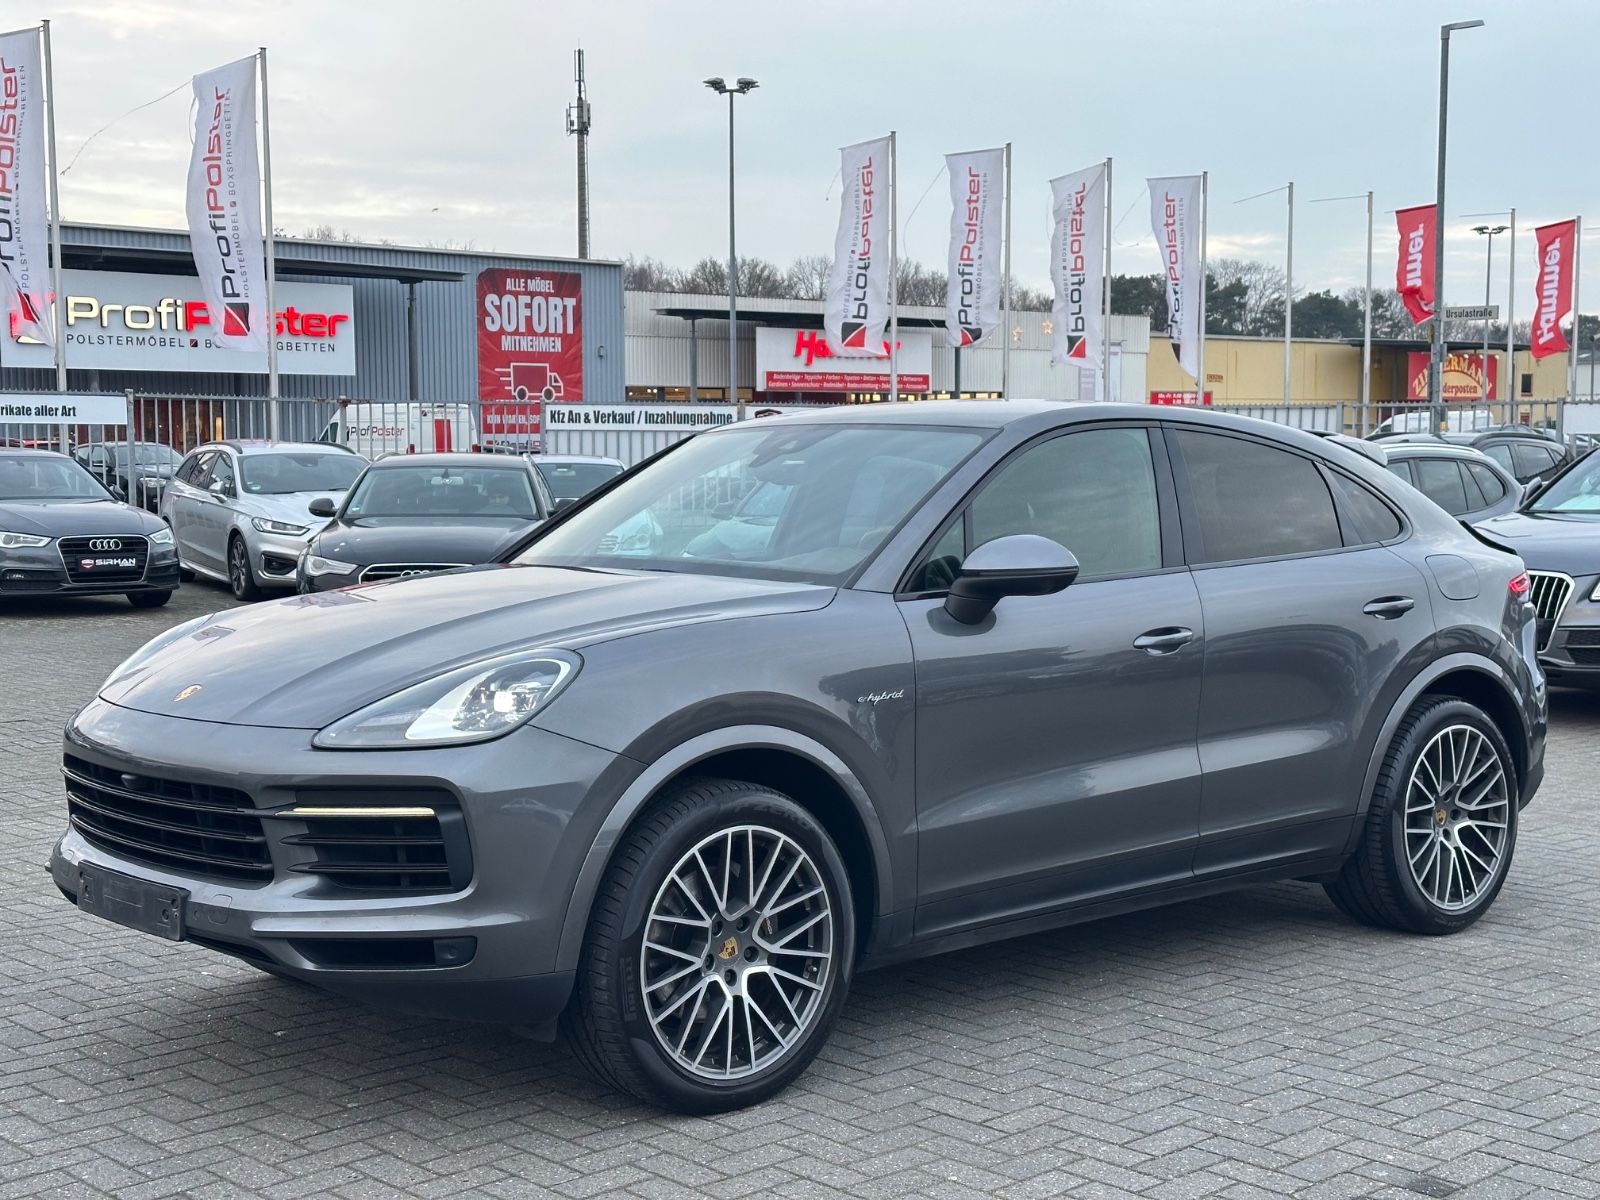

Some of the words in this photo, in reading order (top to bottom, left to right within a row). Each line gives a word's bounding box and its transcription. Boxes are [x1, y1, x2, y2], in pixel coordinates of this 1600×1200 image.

[958, 166, 980, 325] ProfiPolster
[230, 212, 250, 298] POLSTERMÖBEL
[506, 278, 525, 291] ALLE
[527, 277, 554, 292] MÖBEL
[66, 296, 349, 338] ProfiPster
[485, 294, 576, 334] SOFORT
[1446, 308, 1493, 318] Ursulastraße
[66, 333, 185, 347] POLSTERMÖBEL
[501, 335, 561, 352] MITNEHMEN
[34, 405, 60, 416] aller
[61, 405, 76, 416] Art
[550, 410, 565, 423] Kfz
[568, 410, 581, 423] An
[584, 411, 591, 423] &
[593, 410, 635, 424] Verkauf
[644, 411, 733, 426] Inzahlungnahme
[95, 558, 136, 566] SIRHAN
